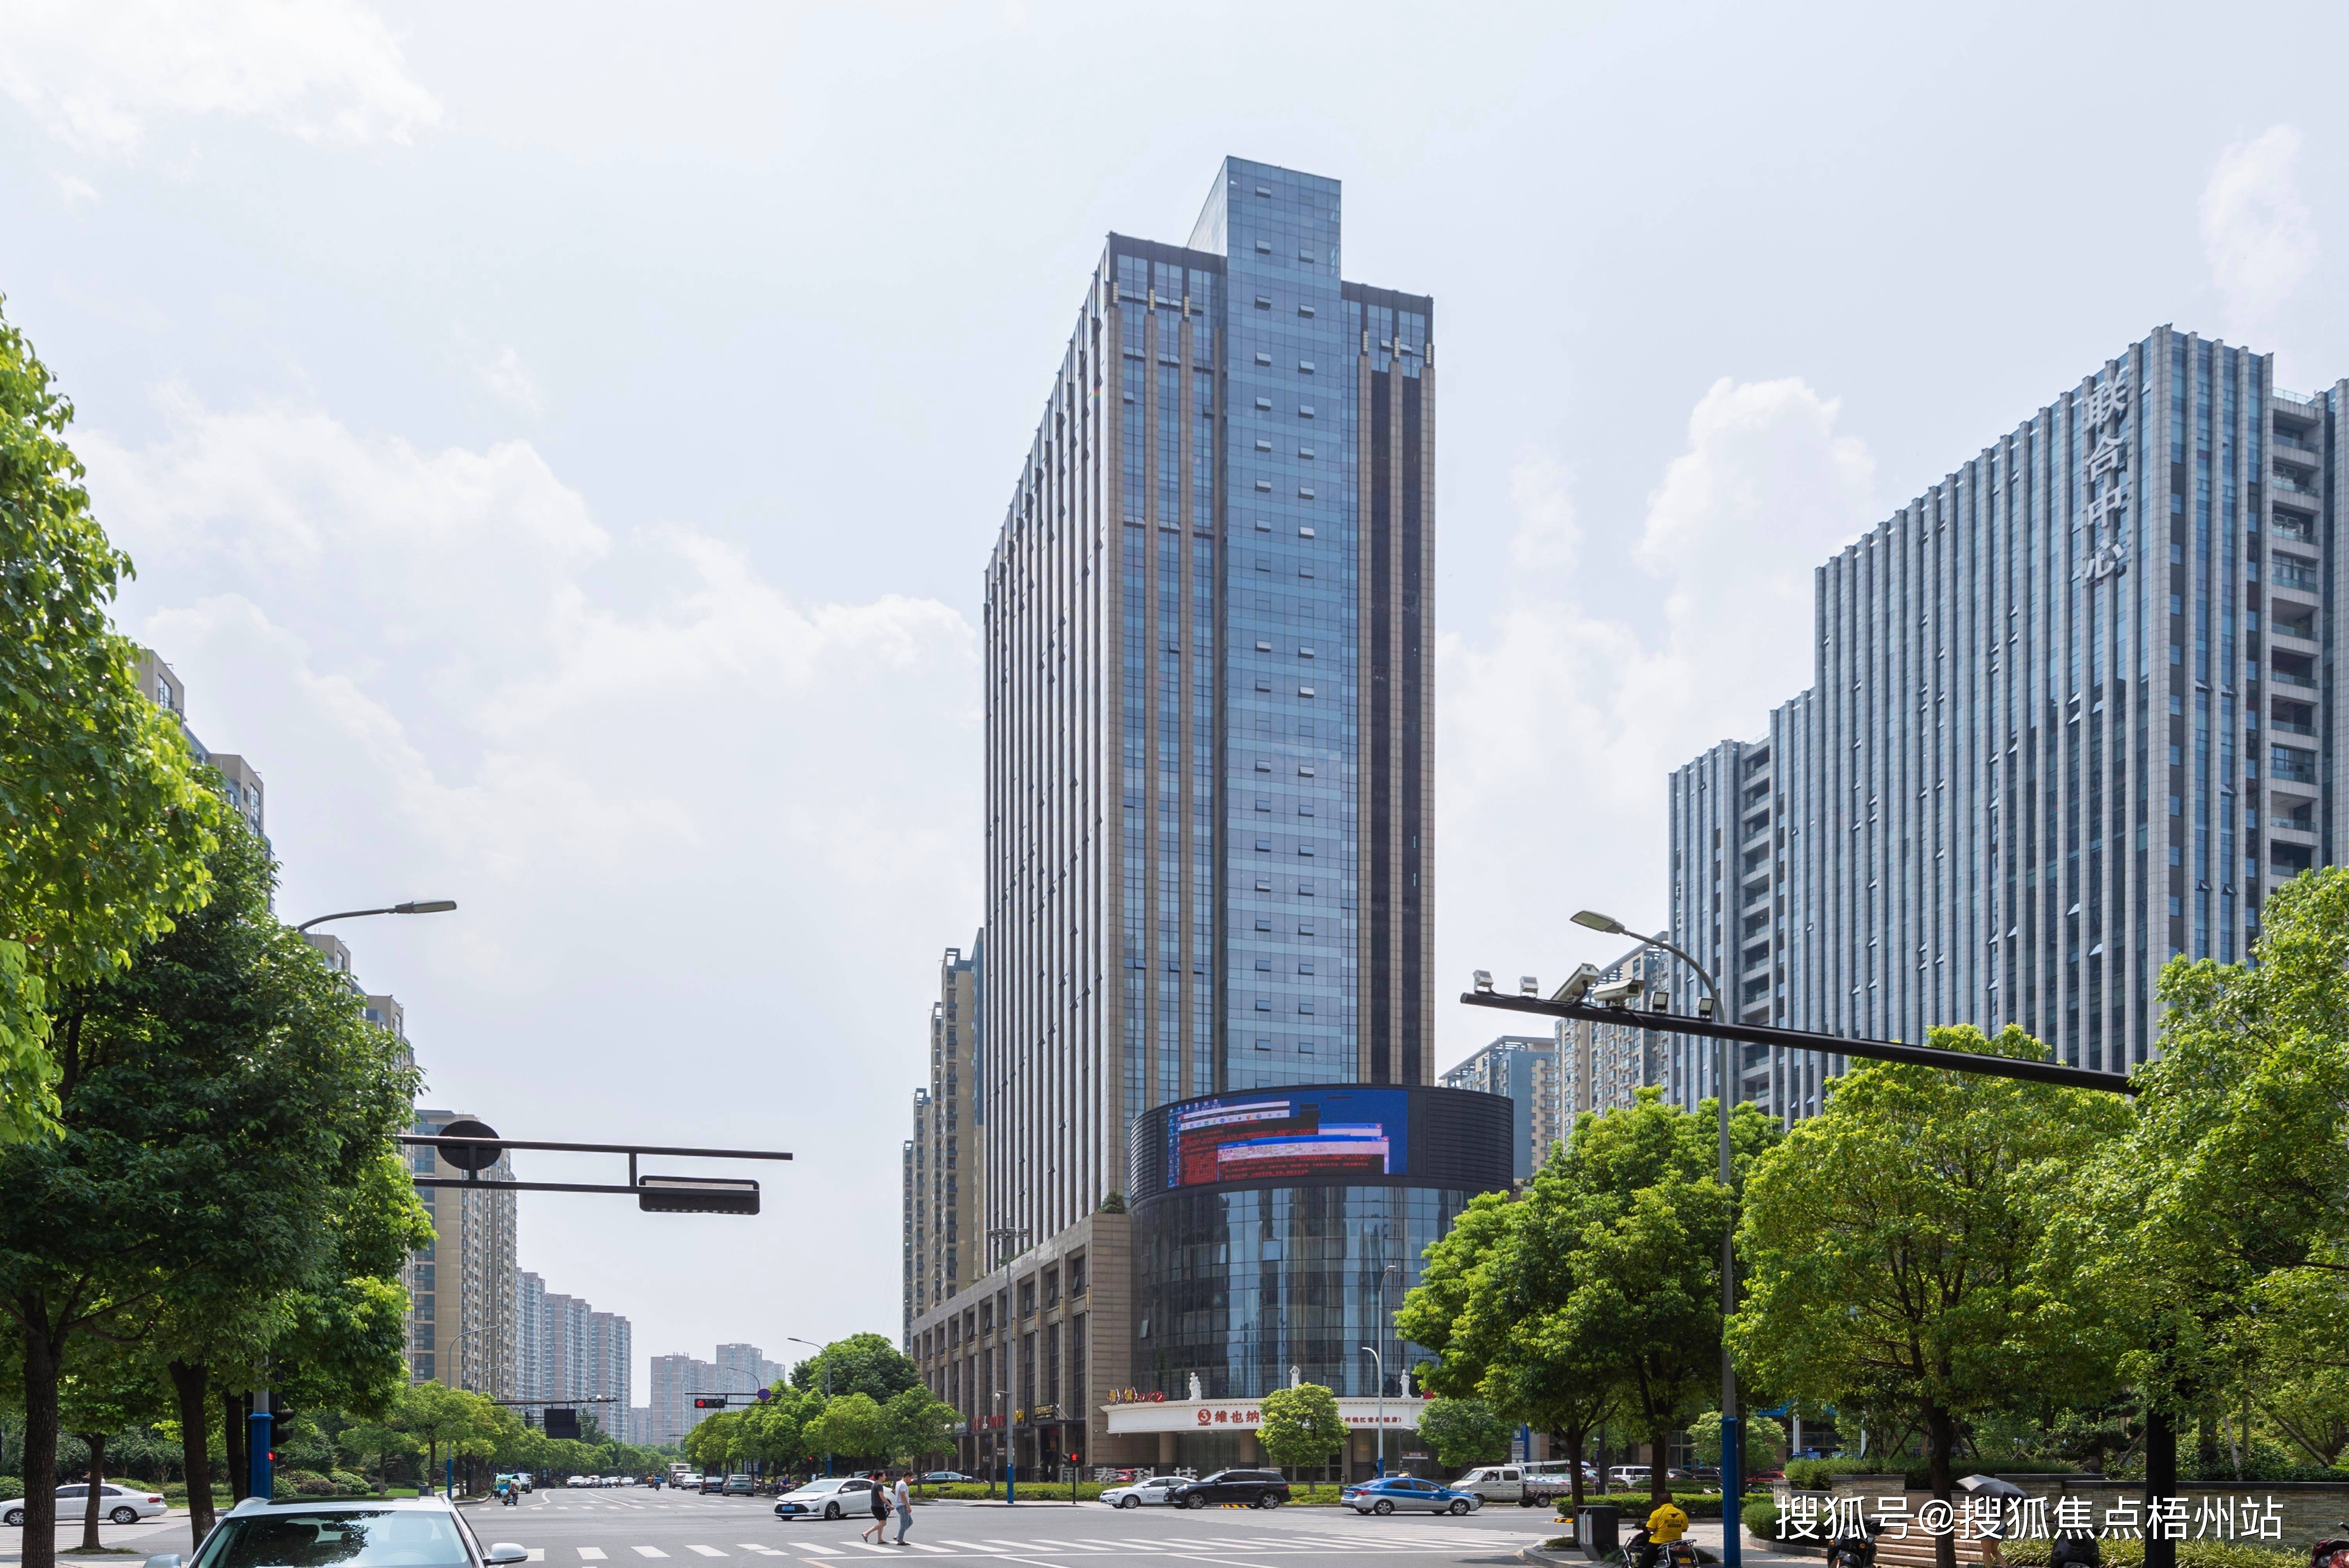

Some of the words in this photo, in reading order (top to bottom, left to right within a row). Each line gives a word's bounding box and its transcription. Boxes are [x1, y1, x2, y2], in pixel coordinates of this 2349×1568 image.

[2085, 372, 2128, 580] 联合中心
[1215, 1410, 1260, 1423] 维也纳
